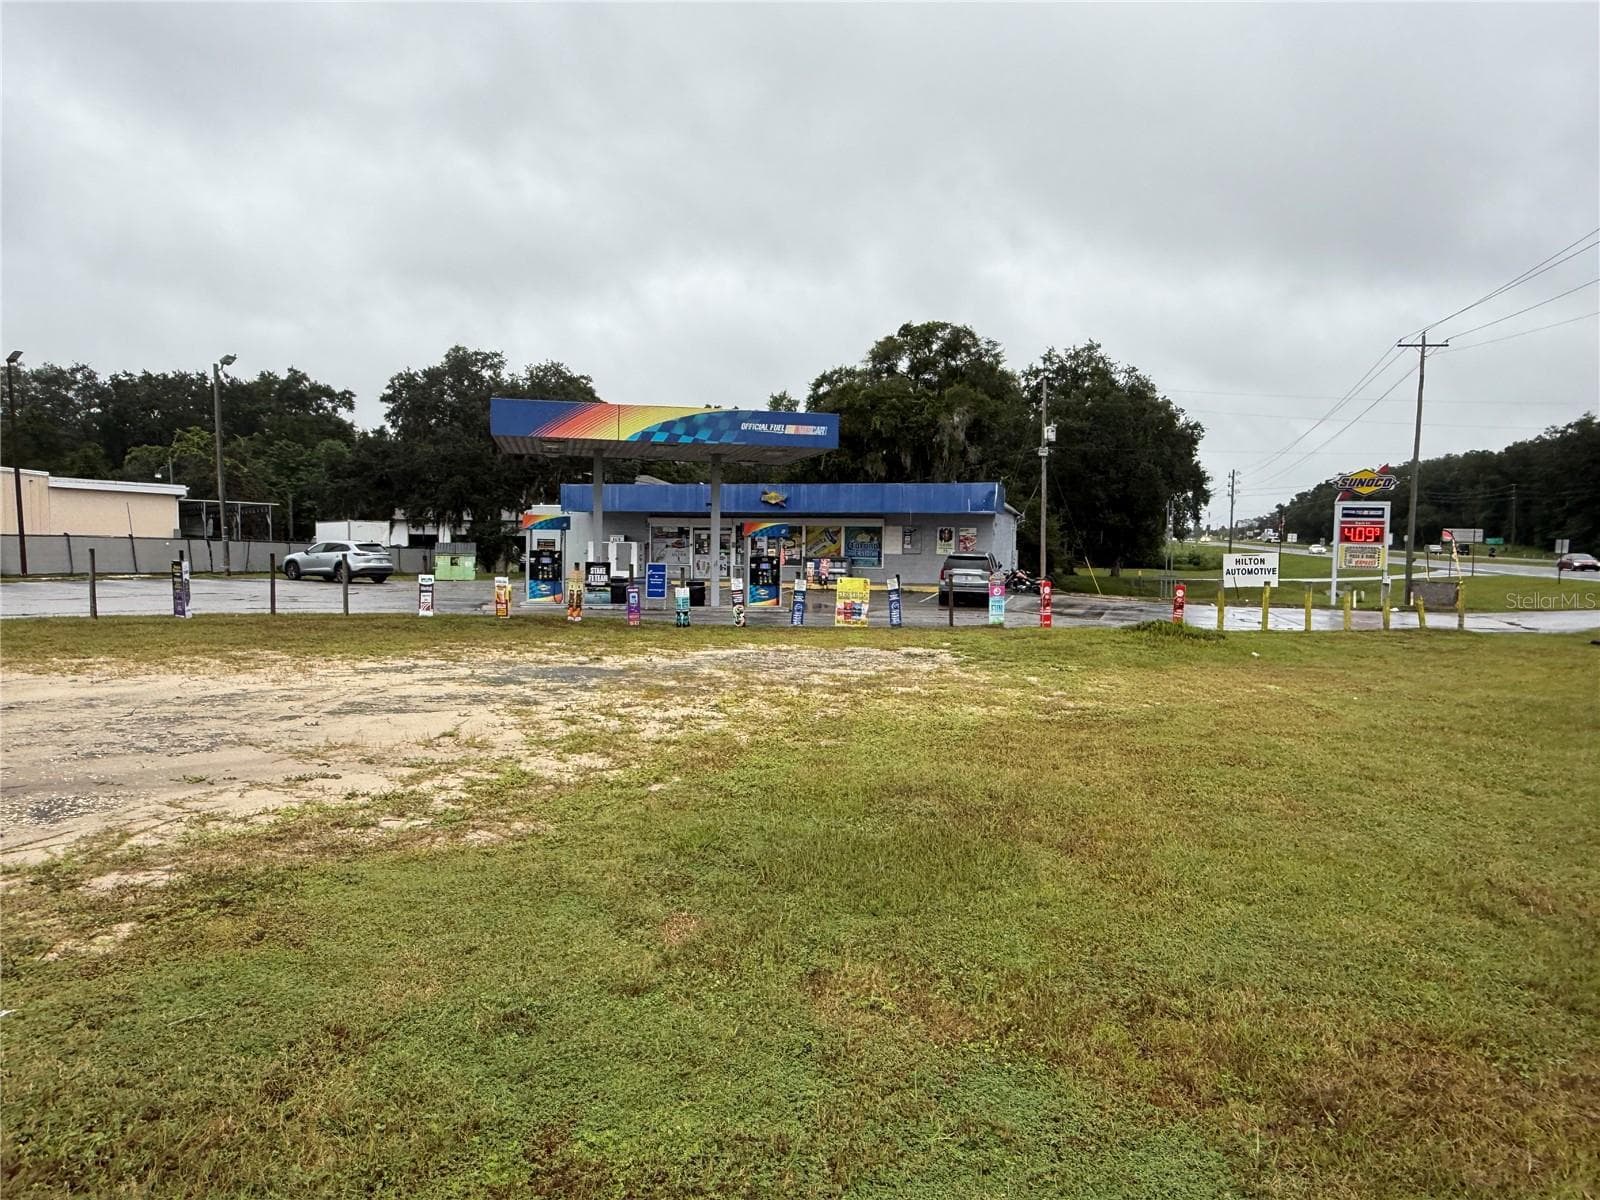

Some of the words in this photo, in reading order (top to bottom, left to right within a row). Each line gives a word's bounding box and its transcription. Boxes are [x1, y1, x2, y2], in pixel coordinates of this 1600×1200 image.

[740, 422, 768, 431] OFFICIAL
[769, 424, 785, 432] FUEL
[1340, 477, 1392, 488] SUNOCO
[1235, 557, 1266, 566] HILTON
[1225, 567, 1277, 576] AUTOMOTIVE
